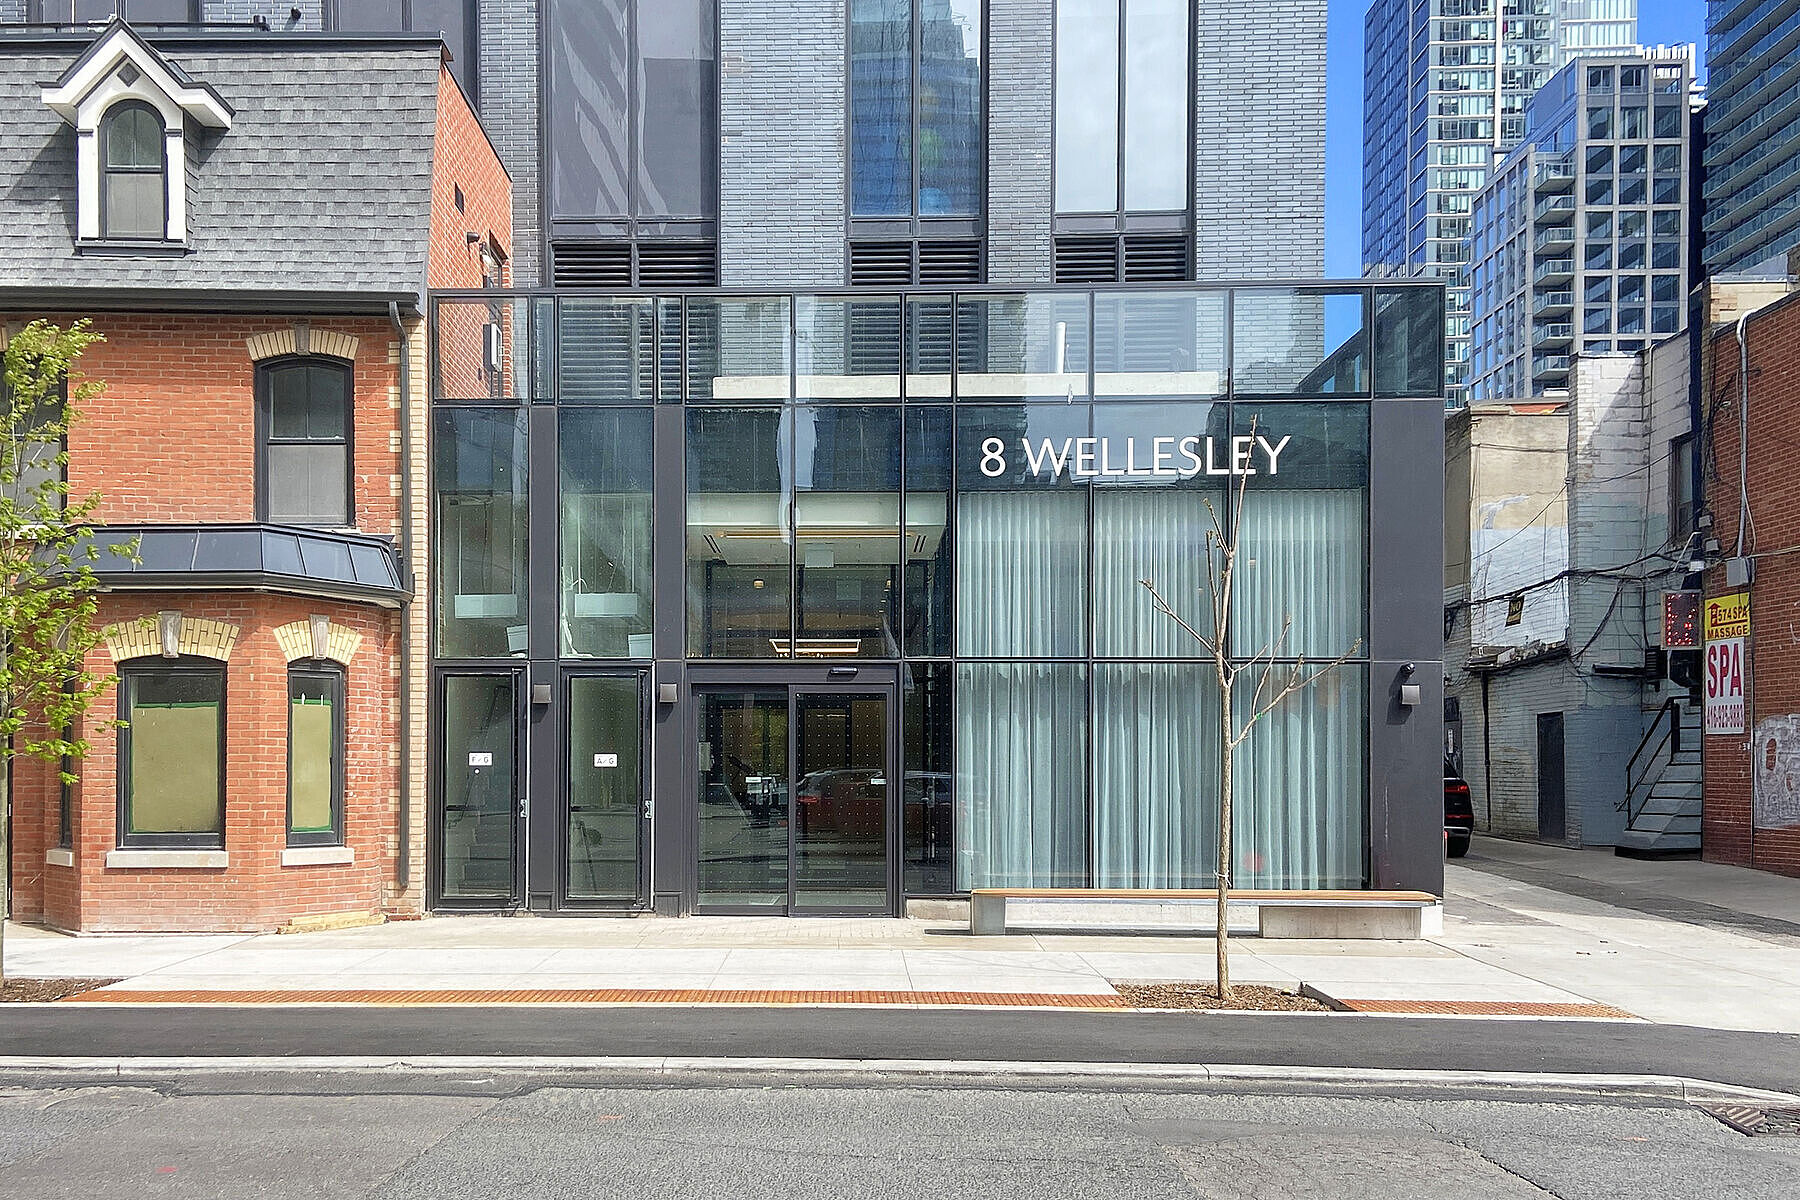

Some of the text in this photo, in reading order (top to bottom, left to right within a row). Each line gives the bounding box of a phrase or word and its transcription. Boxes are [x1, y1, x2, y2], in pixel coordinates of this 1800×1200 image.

[980, 435, 1292, 478] 8 WELLESLEY
[1718, 605, 1748, 622] 574 SPA
[1707, 624, 1748, 638] MASSAGE
[1708, 643, 1742, 698] SPA
